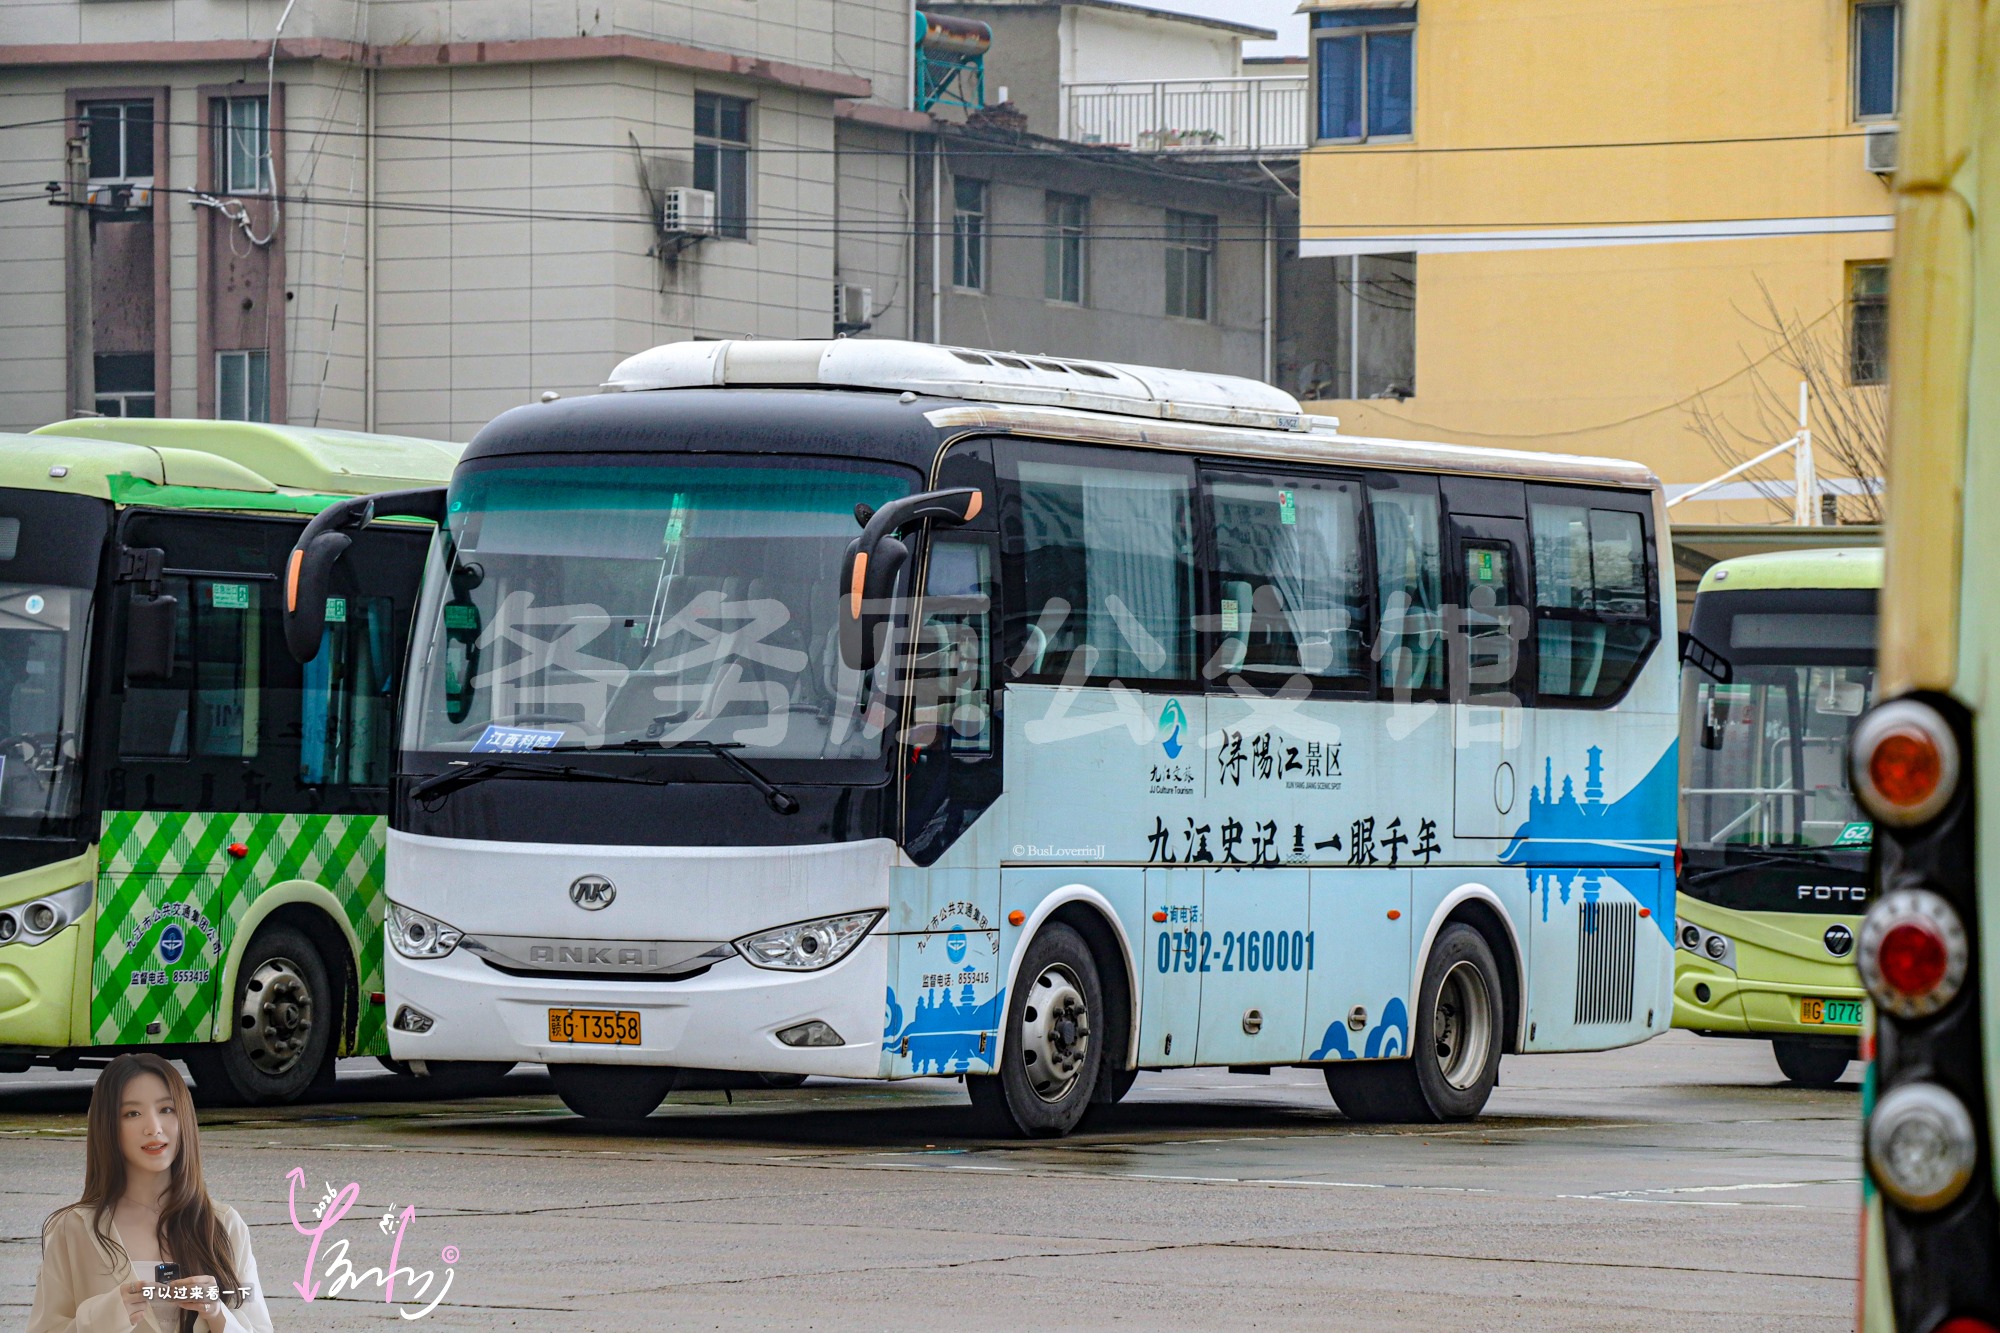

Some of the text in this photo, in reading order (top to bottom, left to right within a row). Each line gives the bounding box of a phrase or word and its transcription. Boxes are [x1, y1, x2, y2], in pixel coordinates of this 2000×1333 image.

[1156, 785, 1174, 795] Culture
[1174, 785, 1194, 795] Tourism
[1147, 816, 1442, 868] 九江史记 一眼千年
[1797, 885, 1870, 900] FOTO
[125, 902, 222, 955] 九江市公共交通集团公司
[530, 945, 659, 967] ANKAI
[1157, 930, 1315, 974] 0792-2160001
[173, 970, 209, 983] 8553416
[958, 972, 990, 984] 8553416
